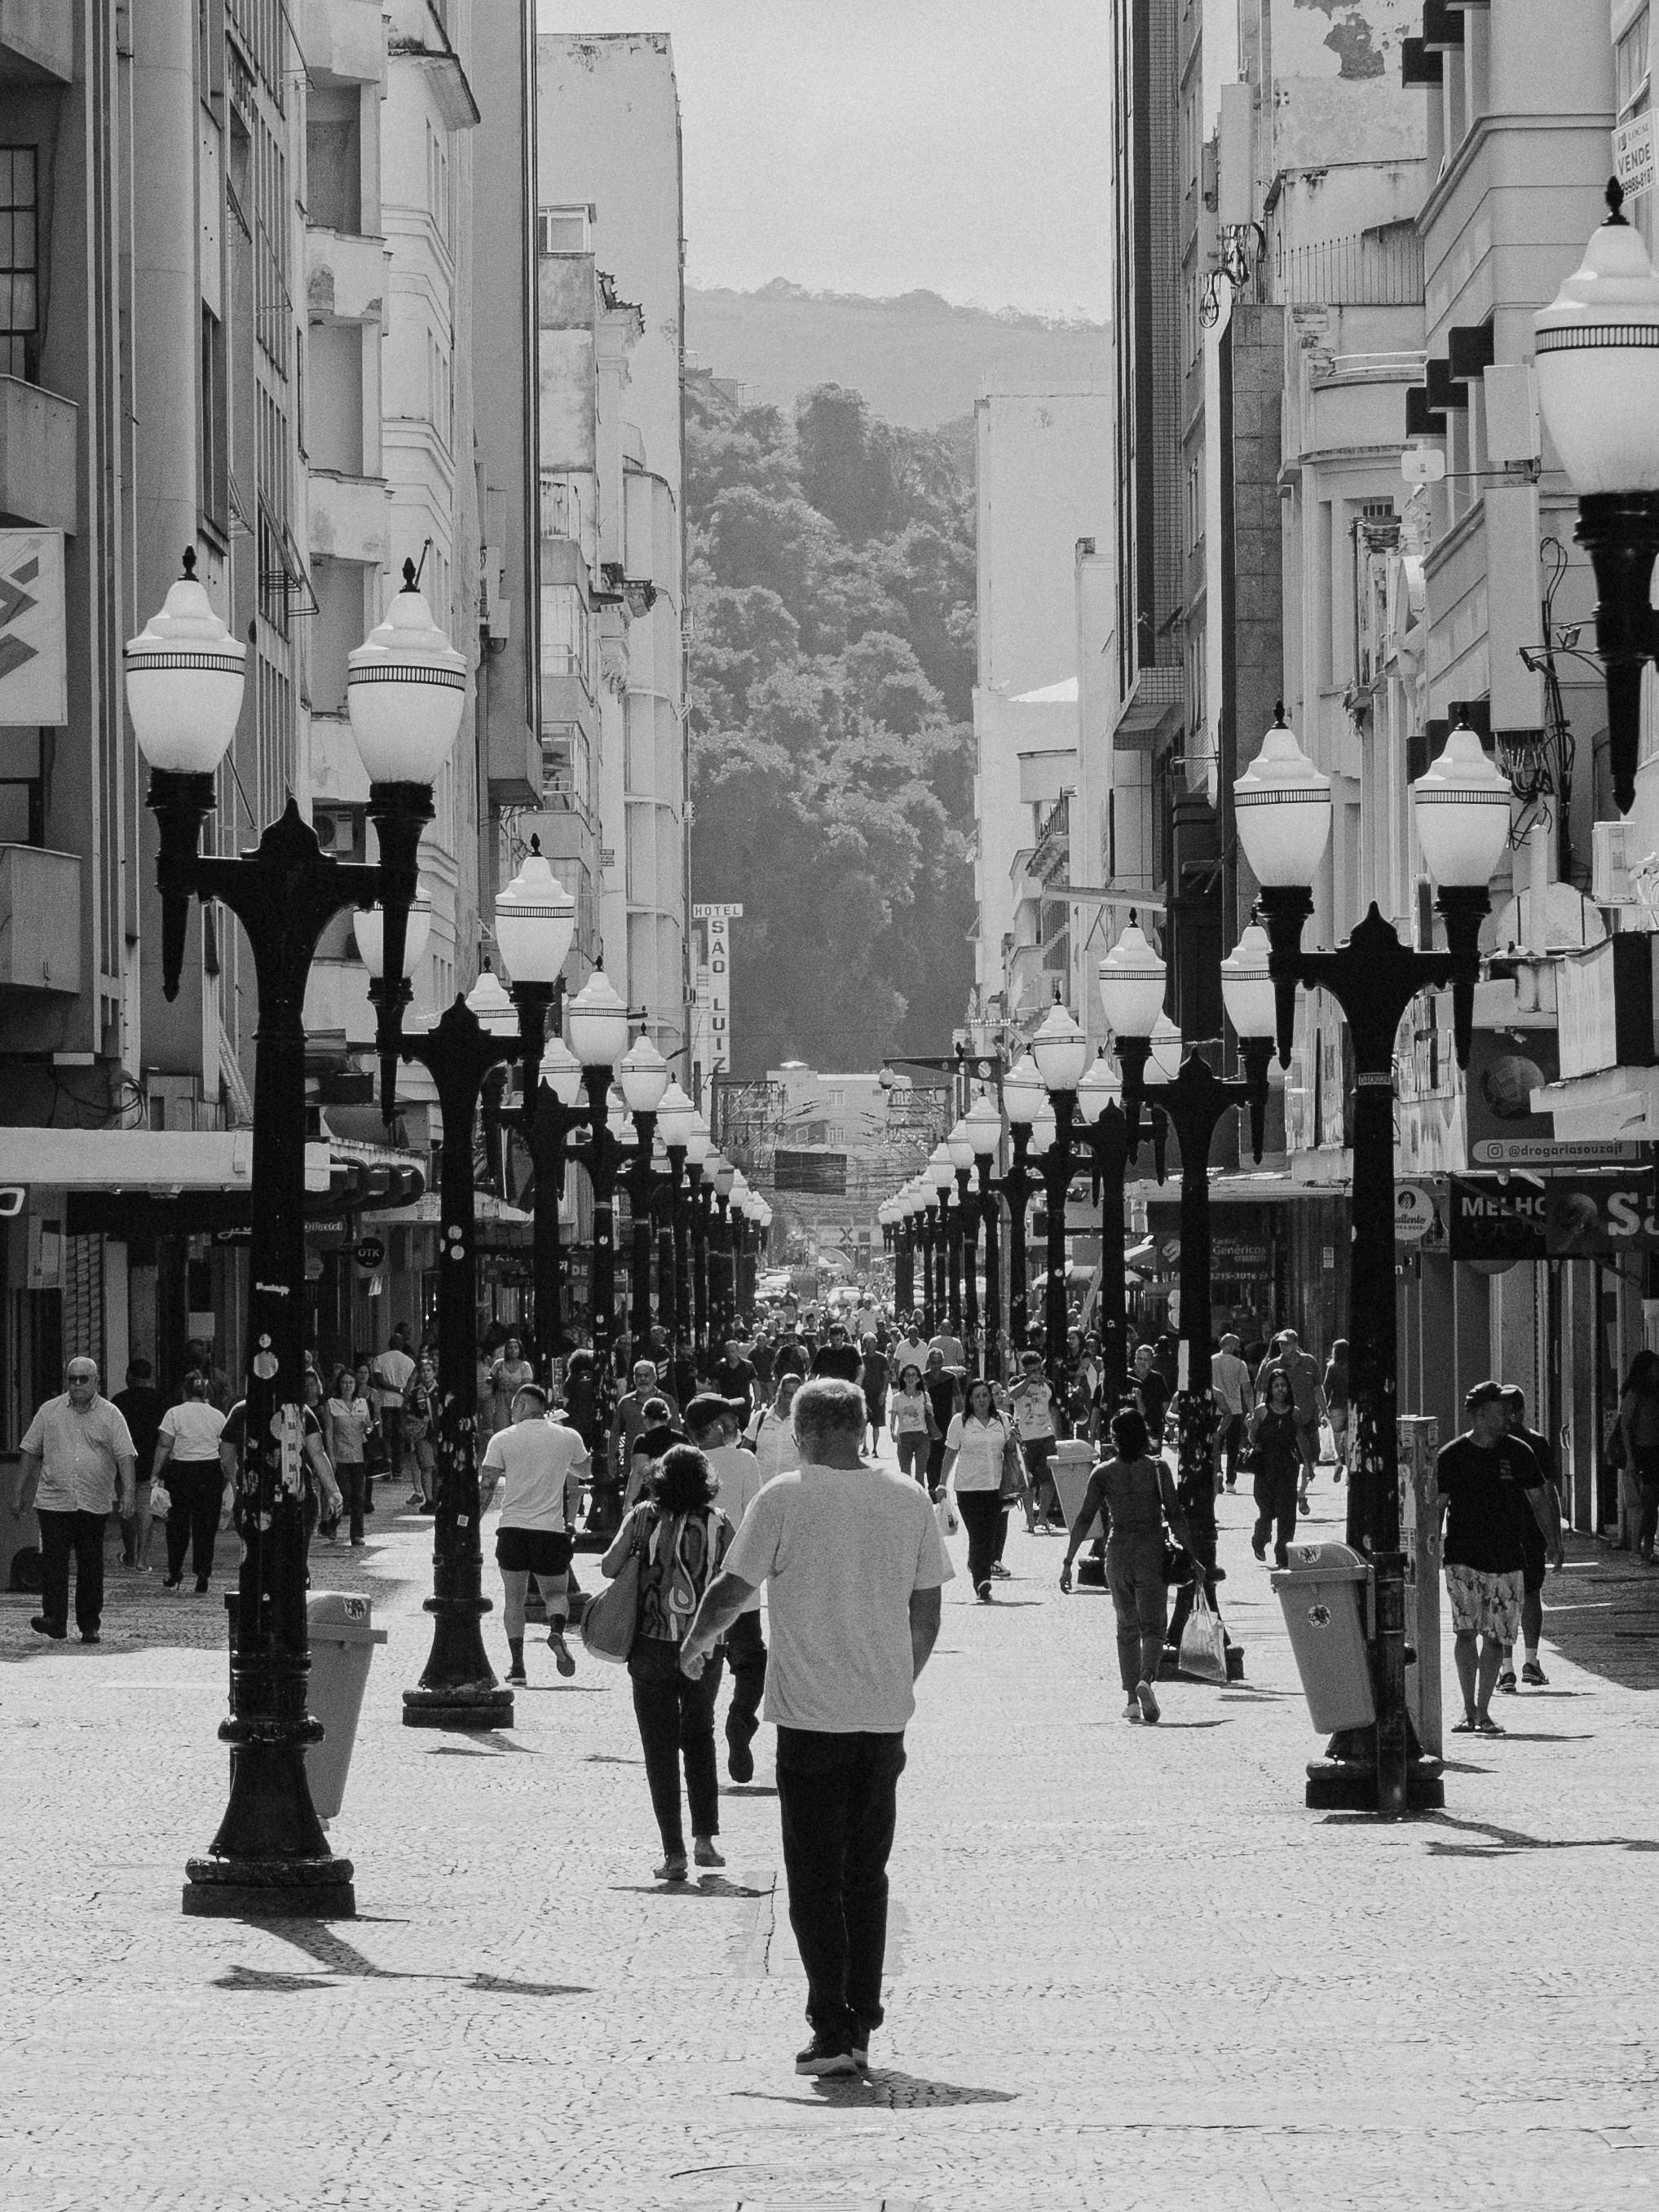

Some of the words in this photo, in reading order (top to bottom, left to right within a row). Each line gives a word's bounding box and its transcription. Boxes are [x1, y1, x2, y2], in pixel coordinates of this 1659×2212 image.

[1618, 142, 1652, 176] VENDE
[695, 906, 740, 916] HOTEL
[712, 920, 726, 974] SÃO
[713, 998, 726, 1071] LUIZ
[1508, 1141, 1623, 1158] @drogariasouzajf
[358, 1247, 381, 1257] OTK
[1212, 1244, 1266, 1256] Genéricos
